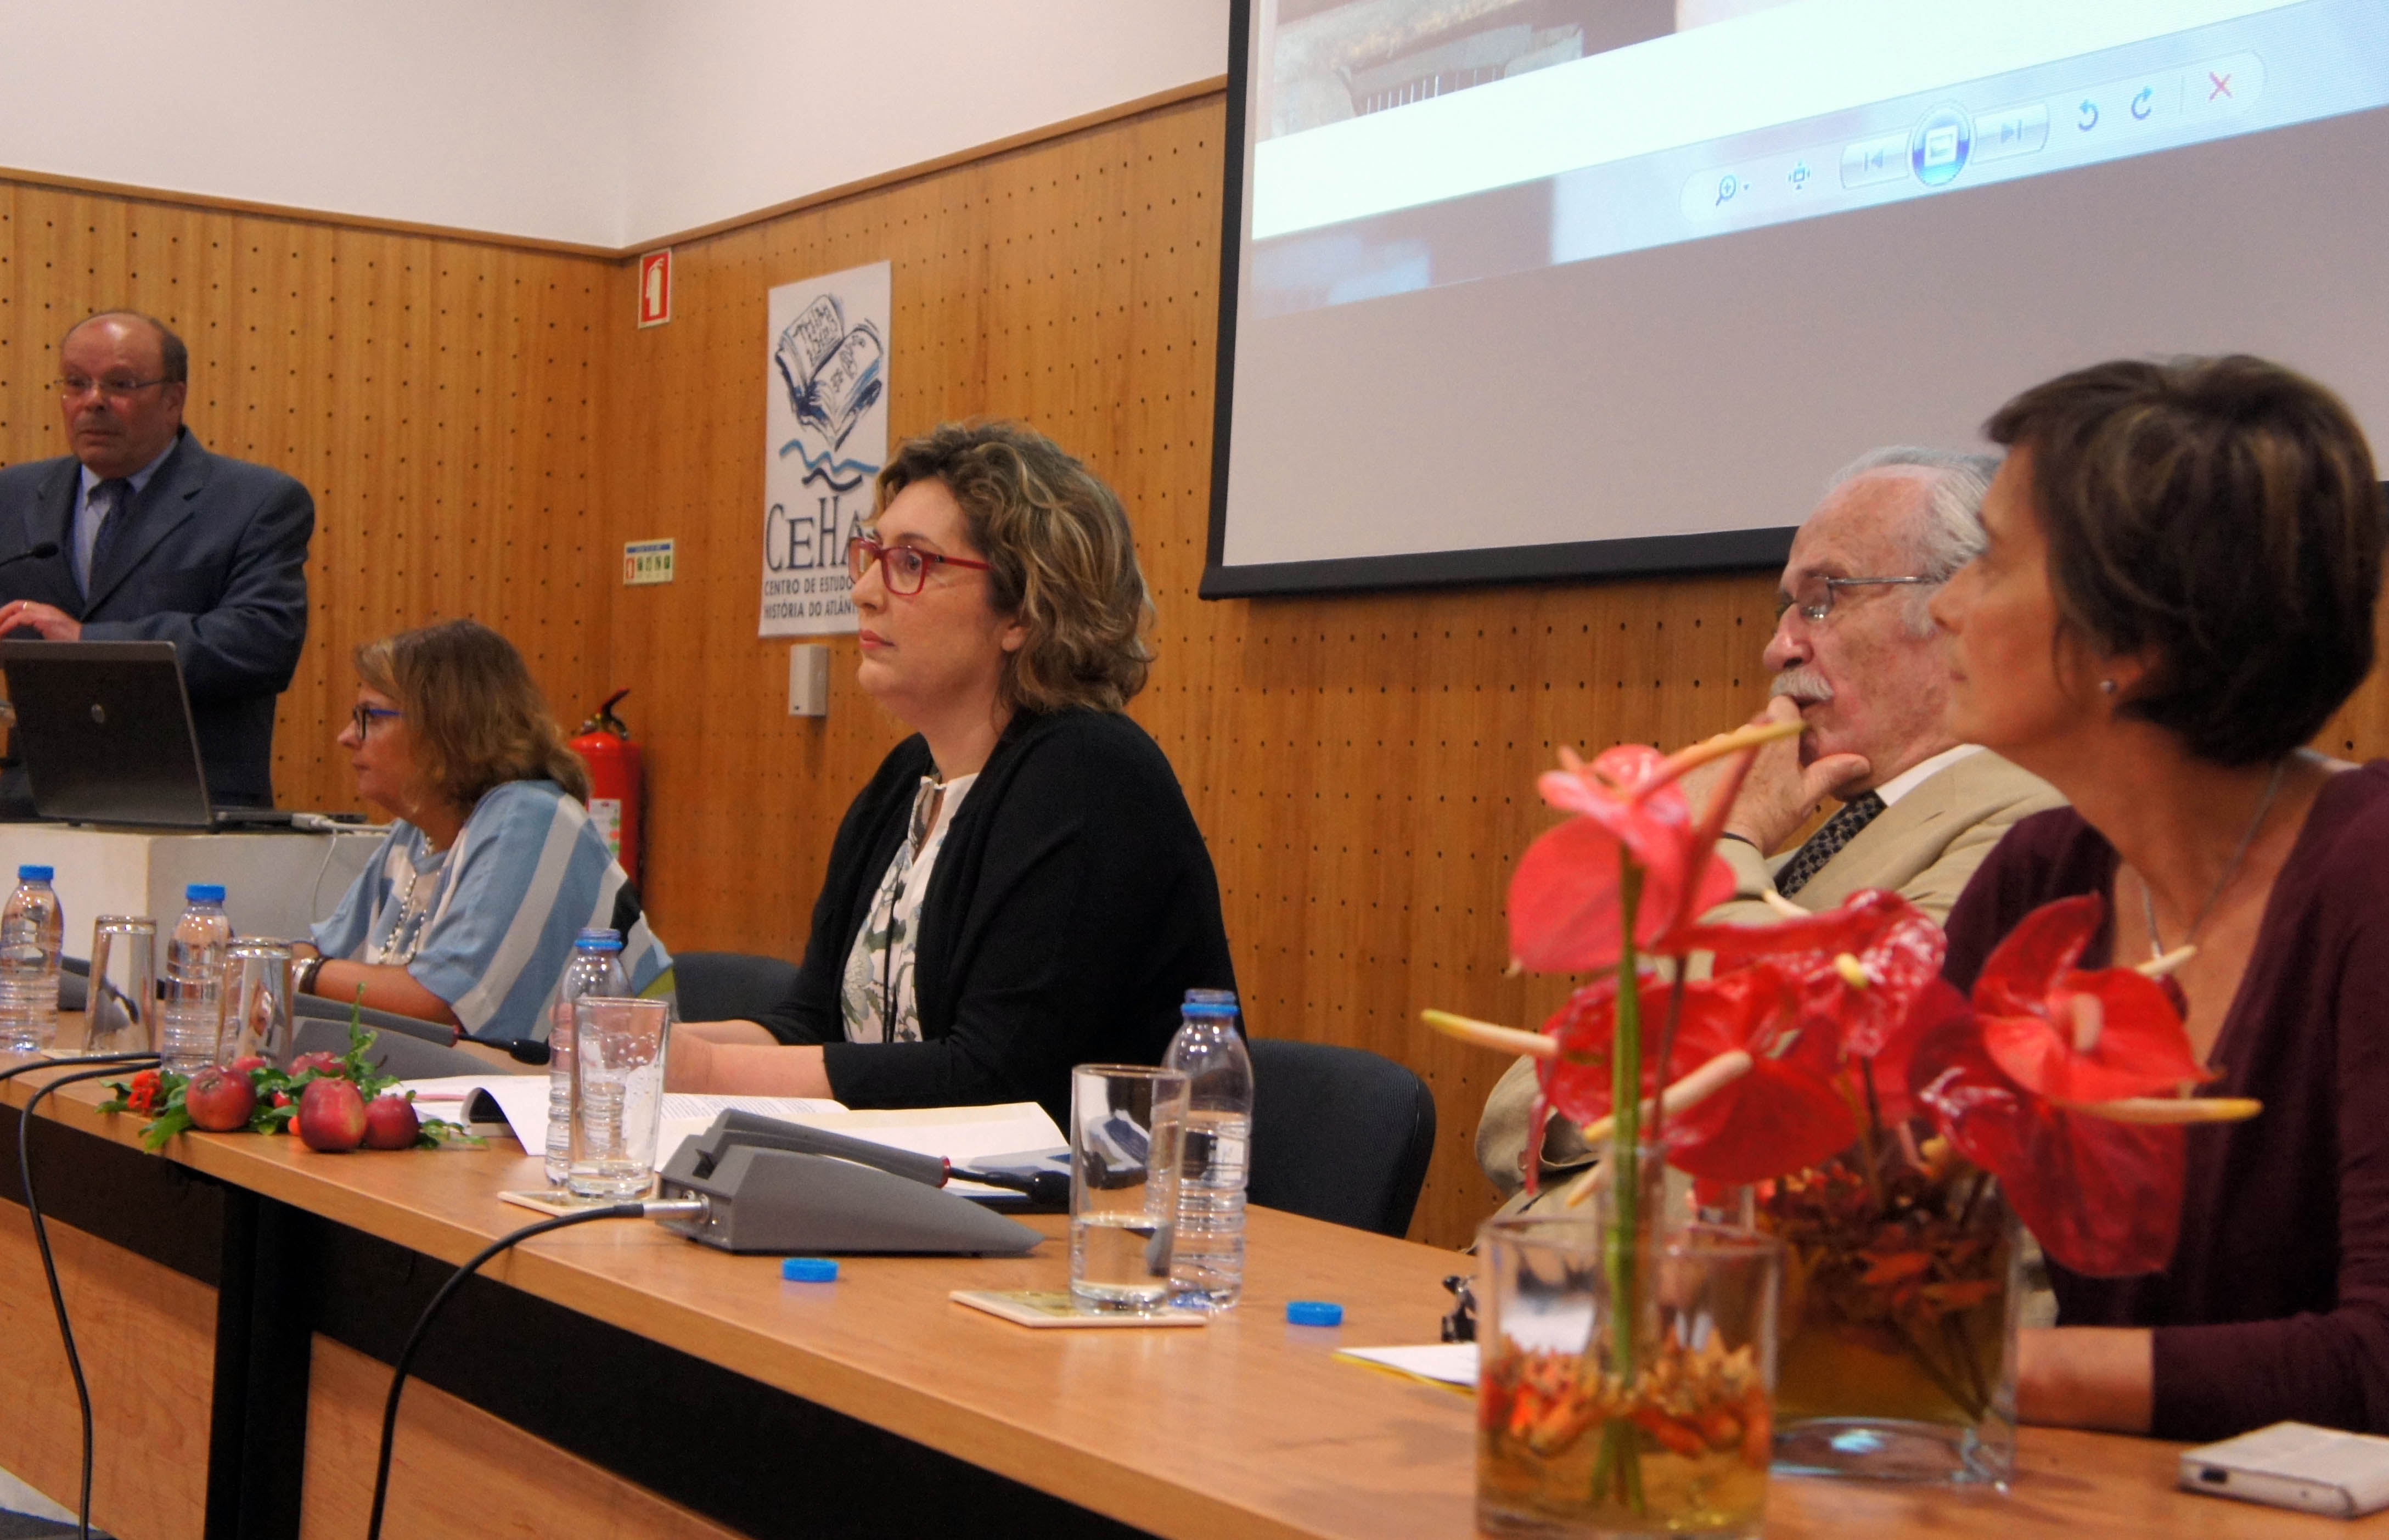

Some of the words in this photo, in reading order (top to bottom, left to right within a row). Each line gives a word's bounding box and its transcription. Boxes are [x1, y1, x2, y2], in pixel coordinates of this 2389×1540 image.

[765, 578, 800, 596] CENTRO
[803, 577, 816, 593] DE
[763, 599, 805, 619] HISTÓRIA
[808, 601, 822, 617] DO
